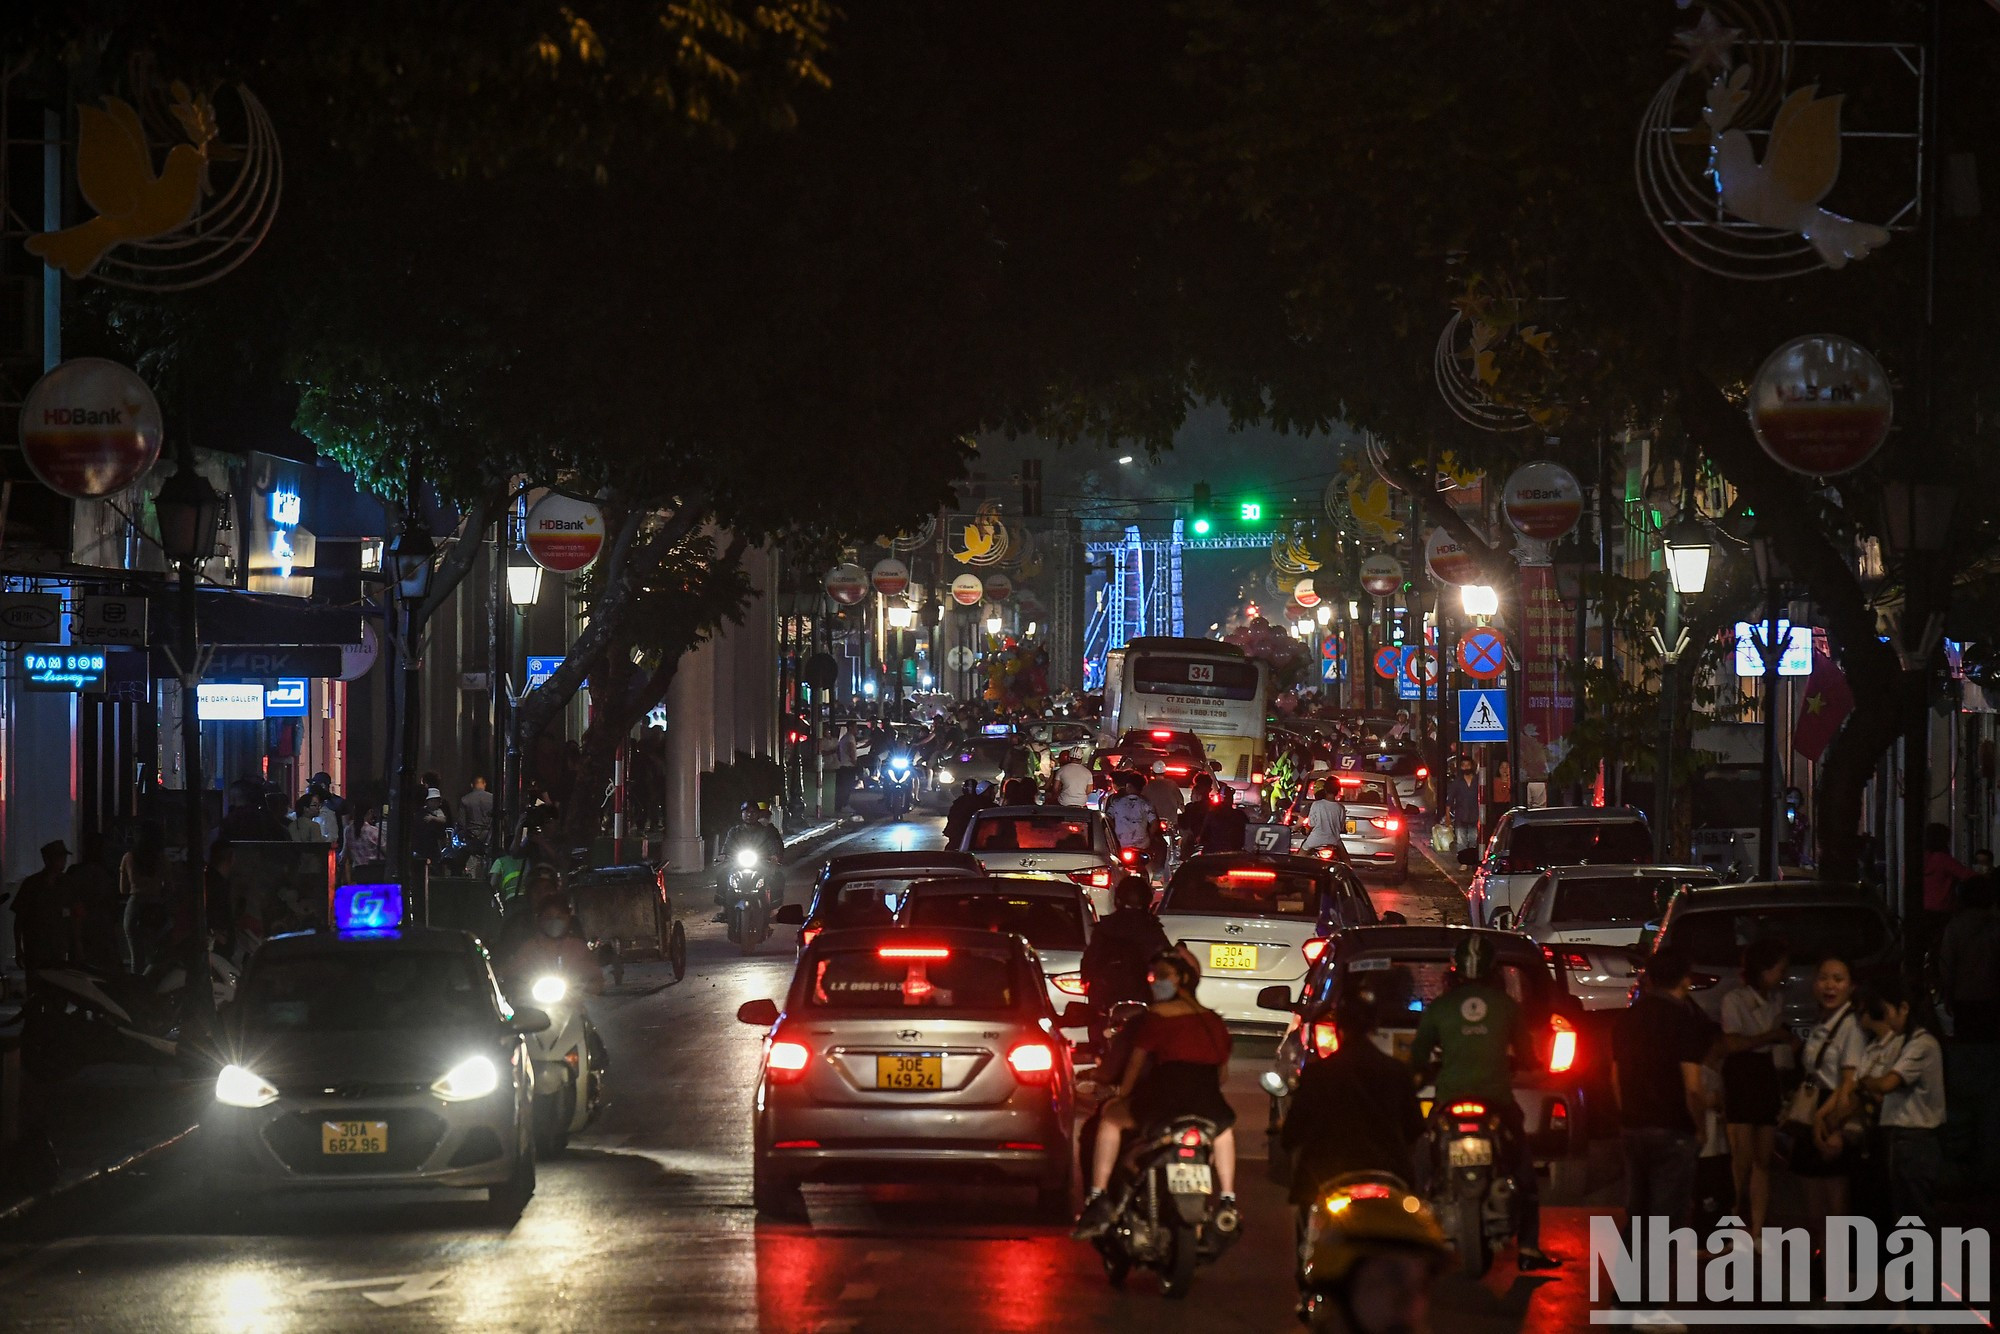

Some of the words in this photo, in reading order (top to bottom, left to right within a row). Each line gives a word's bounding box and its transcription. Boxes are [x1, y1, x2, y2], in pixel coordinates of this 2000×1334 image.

[44, 408, 122, 425] HDBank
[1517, 489, 1562, 500] HDBank
[1241, 503, 1261, 520] 30
[539, 520, 584, 531] HDBank
[25, 656, 62, 669] TAM
[67, 656, 104, 669] SON
[1191, 666, 1210, 680] 34
[1255, 827, 1280, 851] G7
[351, 890, 385, 925] G7
[1224, 947, 1242, 957] 30A
[896, 1058, 923, 1072] 30E
[886, 1073, 934, 1089] 149.24
[341, 1123, 367, 1137] 30A
[329, 1138, 380, 1152] 682.96
